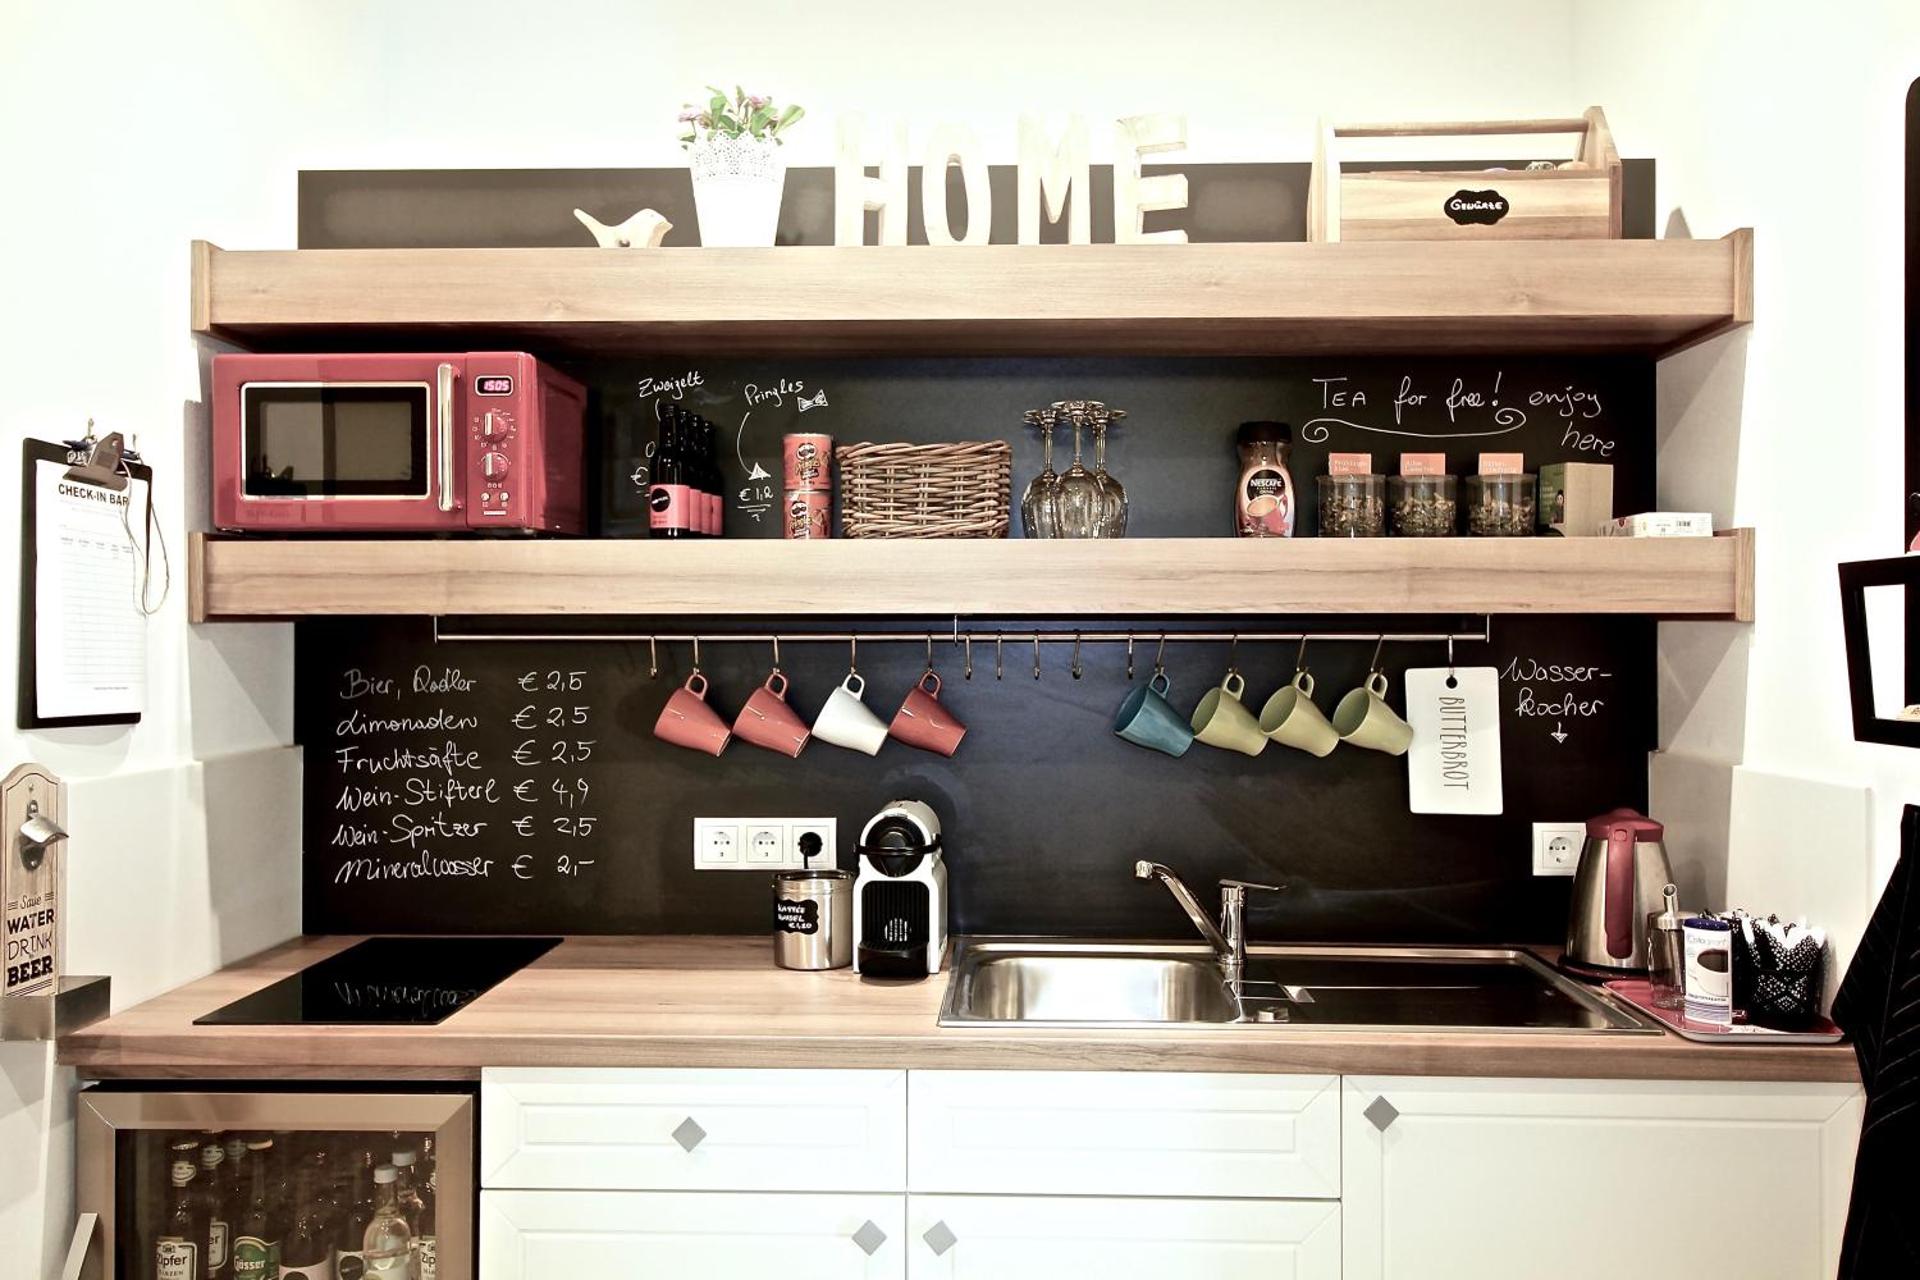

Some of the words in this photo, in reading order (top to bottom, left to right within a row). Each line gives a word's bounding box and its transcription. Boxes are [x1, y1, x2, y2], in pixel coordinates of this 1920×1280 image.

[834, 111, 1188, 246] HOME
[744, 379, 804, 407] Pringles
[1394, 376, 1428, 424] for
[1446, 372, 1502, 423] free!
[1529, 386, 1602, 418] enjoy
[1561, 421, 1615, 456] here
[58, 483, 106, 502] CHECK-IN
[340, 668, 401, 700] Bier,
[517, 671, 538, 692] €
[547, 670, 588, 692] 2,5
[1500, 656, 1613, 683] Wasser-
[336, 708, 478, 736] Limonaden
[511, 705, 537, 730] €
[546, 706, 590, 728] 2,5
[511, 739, 541, 766] €
[551, 740, 597, 764] 2,5
[1438, 696, 1470, 790] BUTTERBROT
[512, 779, 538, 803] €
[552, 778, 589, 809] 4,9
[511, 815, 535, 837] €
[552, 817, 598, 837] 2,5
[511, 854, 533, 879] €
[7, 908, 55, 934] WATER
[7, 931, 52, 960] DRINK
[7, 955, 53, 987] BEER
